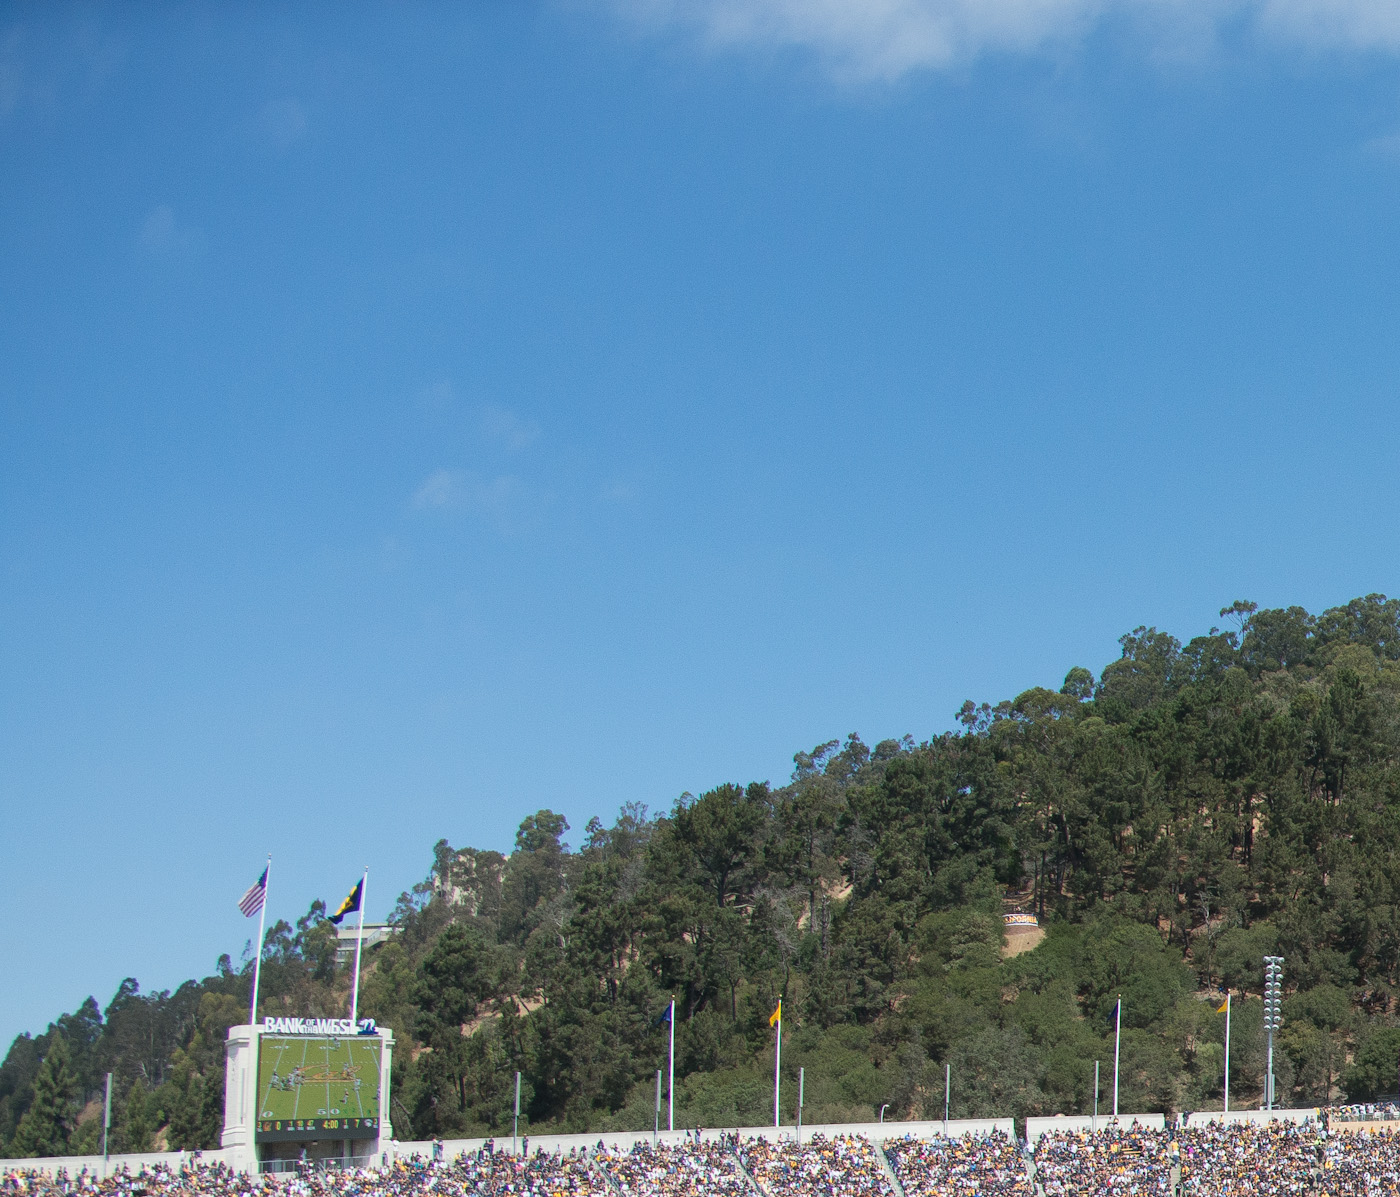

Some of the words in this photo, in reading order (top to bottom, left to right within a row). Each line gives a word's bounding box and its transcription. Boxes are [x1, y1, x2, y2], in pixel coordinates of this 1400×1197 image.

[264, 1017, 305, 1034] BANK
[316, 1018, 356, 1034] WEST
[323, 1120, 338, 1129] 4:00
